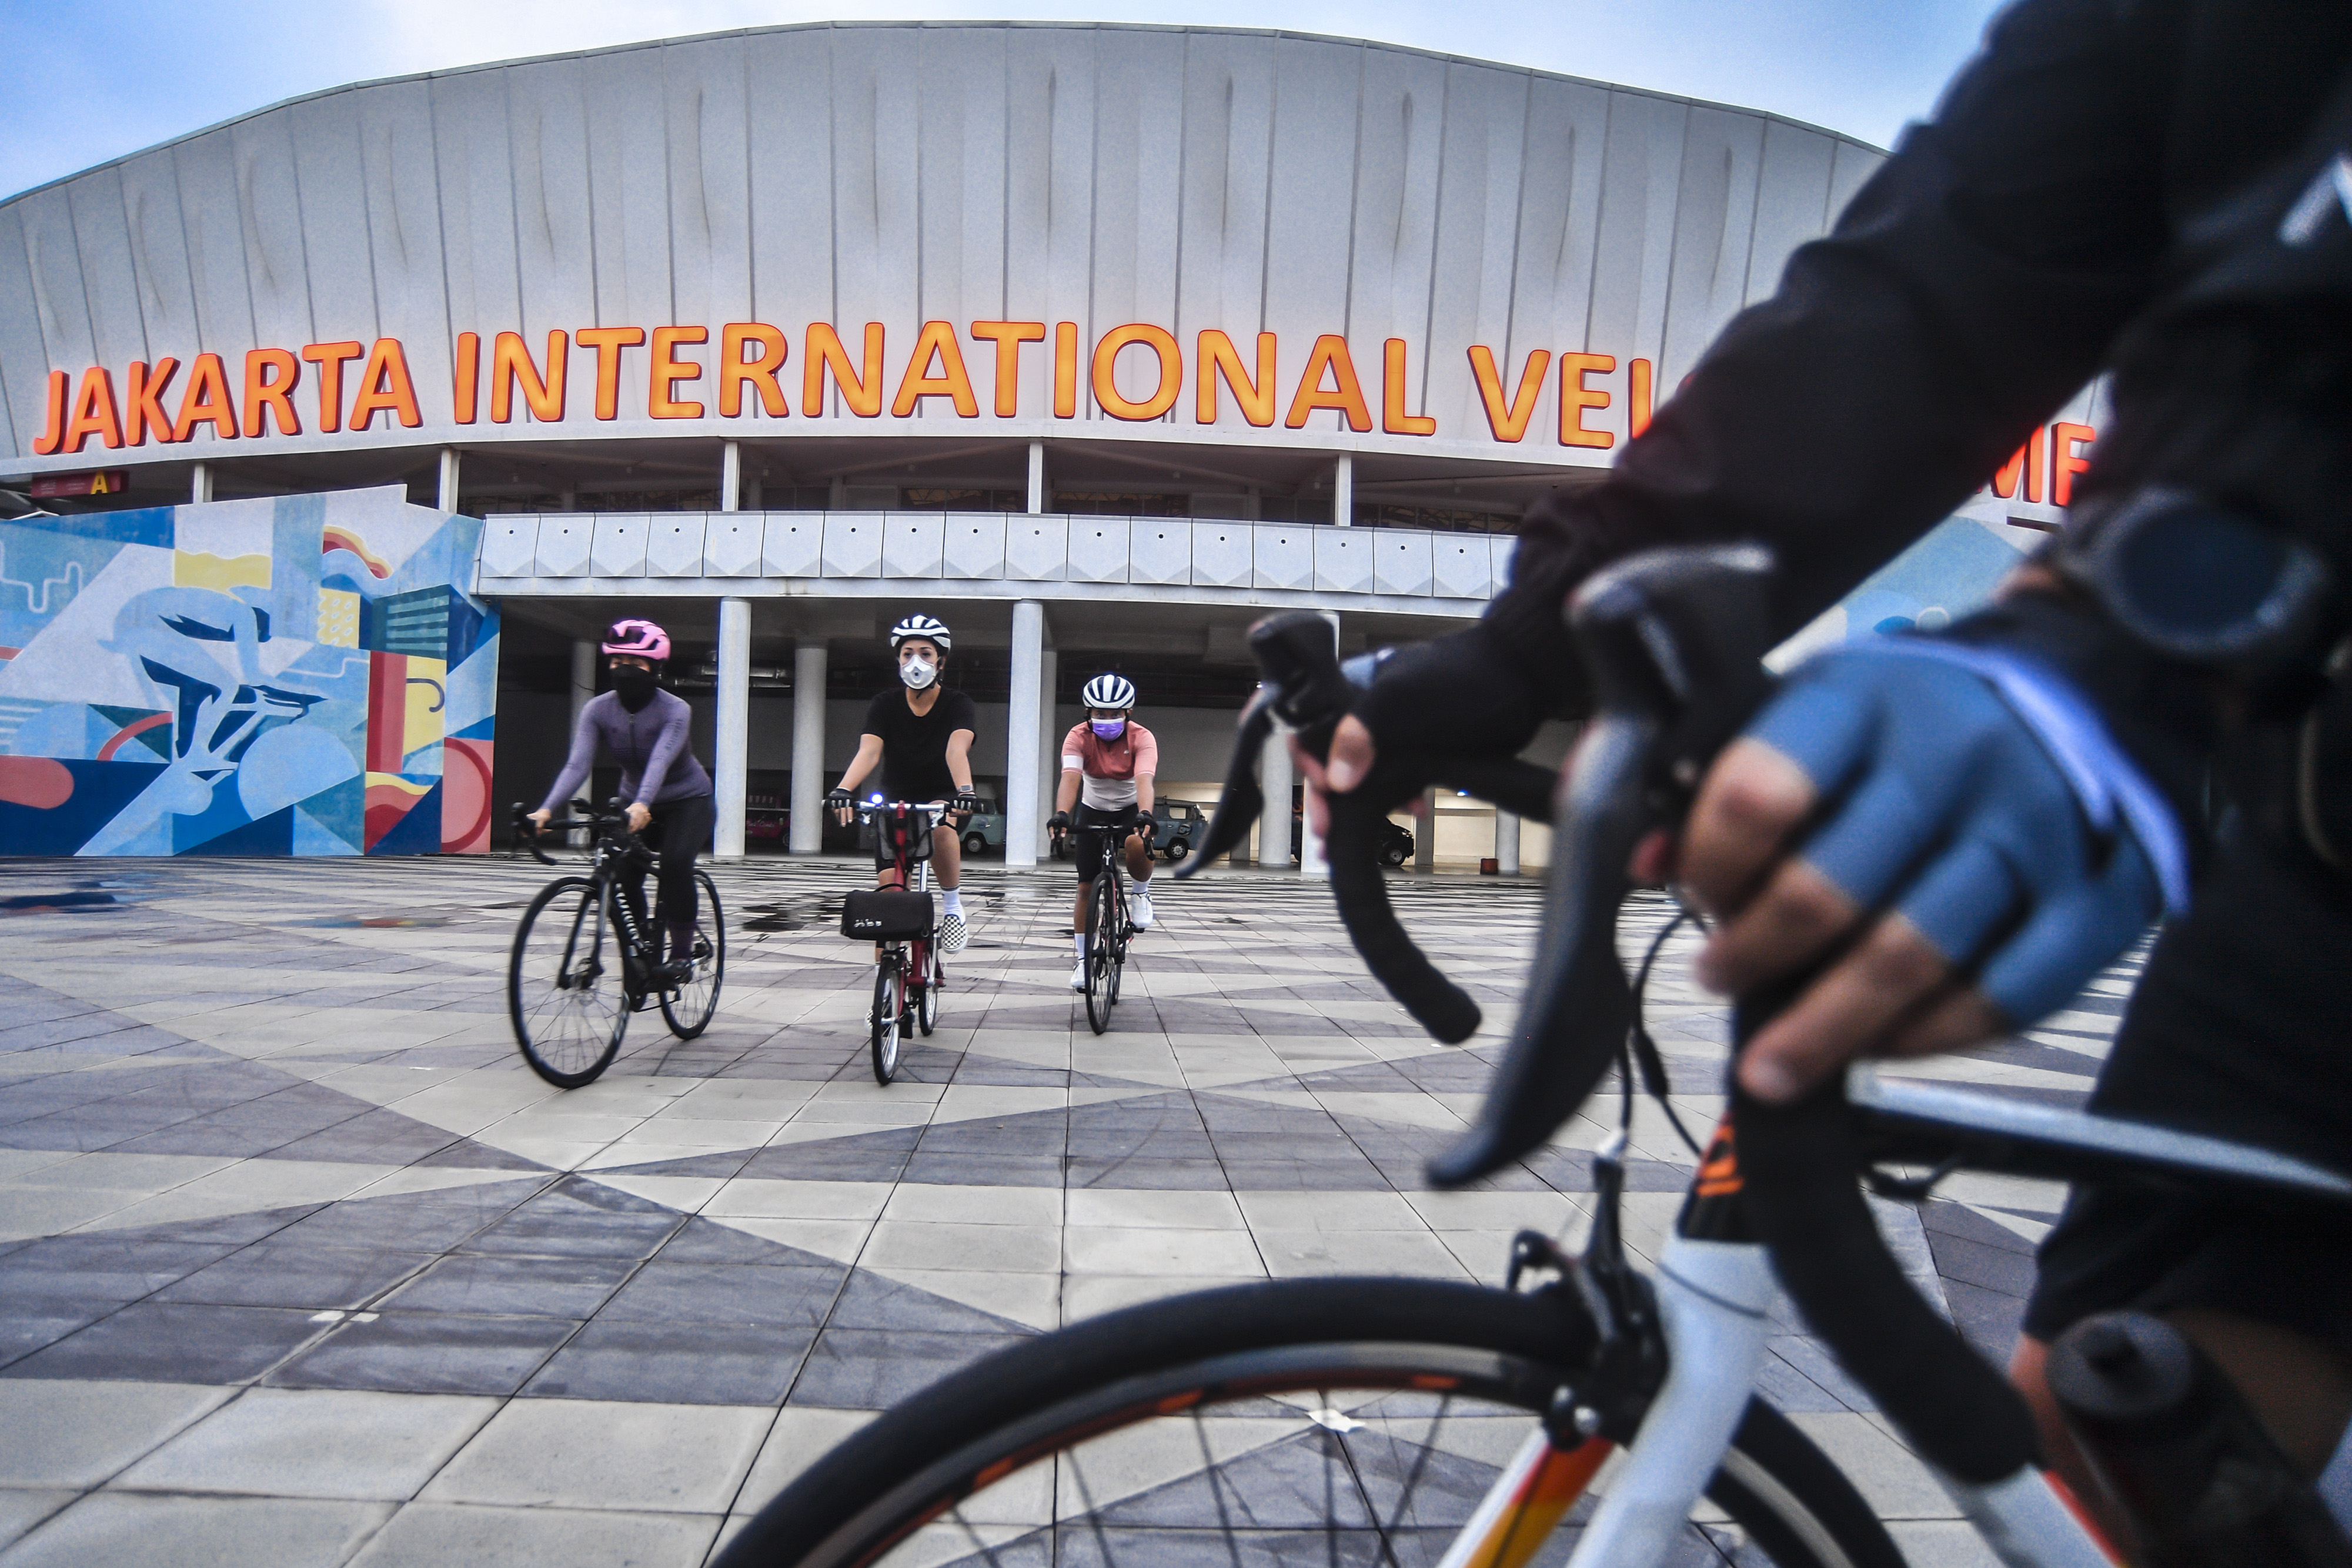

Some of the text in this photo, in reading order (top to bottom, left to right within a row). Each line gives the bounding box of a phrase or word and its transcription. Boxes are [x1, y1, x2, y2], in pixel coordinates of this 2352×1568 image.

[34, 337, 423, 455] JAKARTA
[454, 320, 1436, 436] INTERNATIONAL
[90, 470, 110, 495] A
